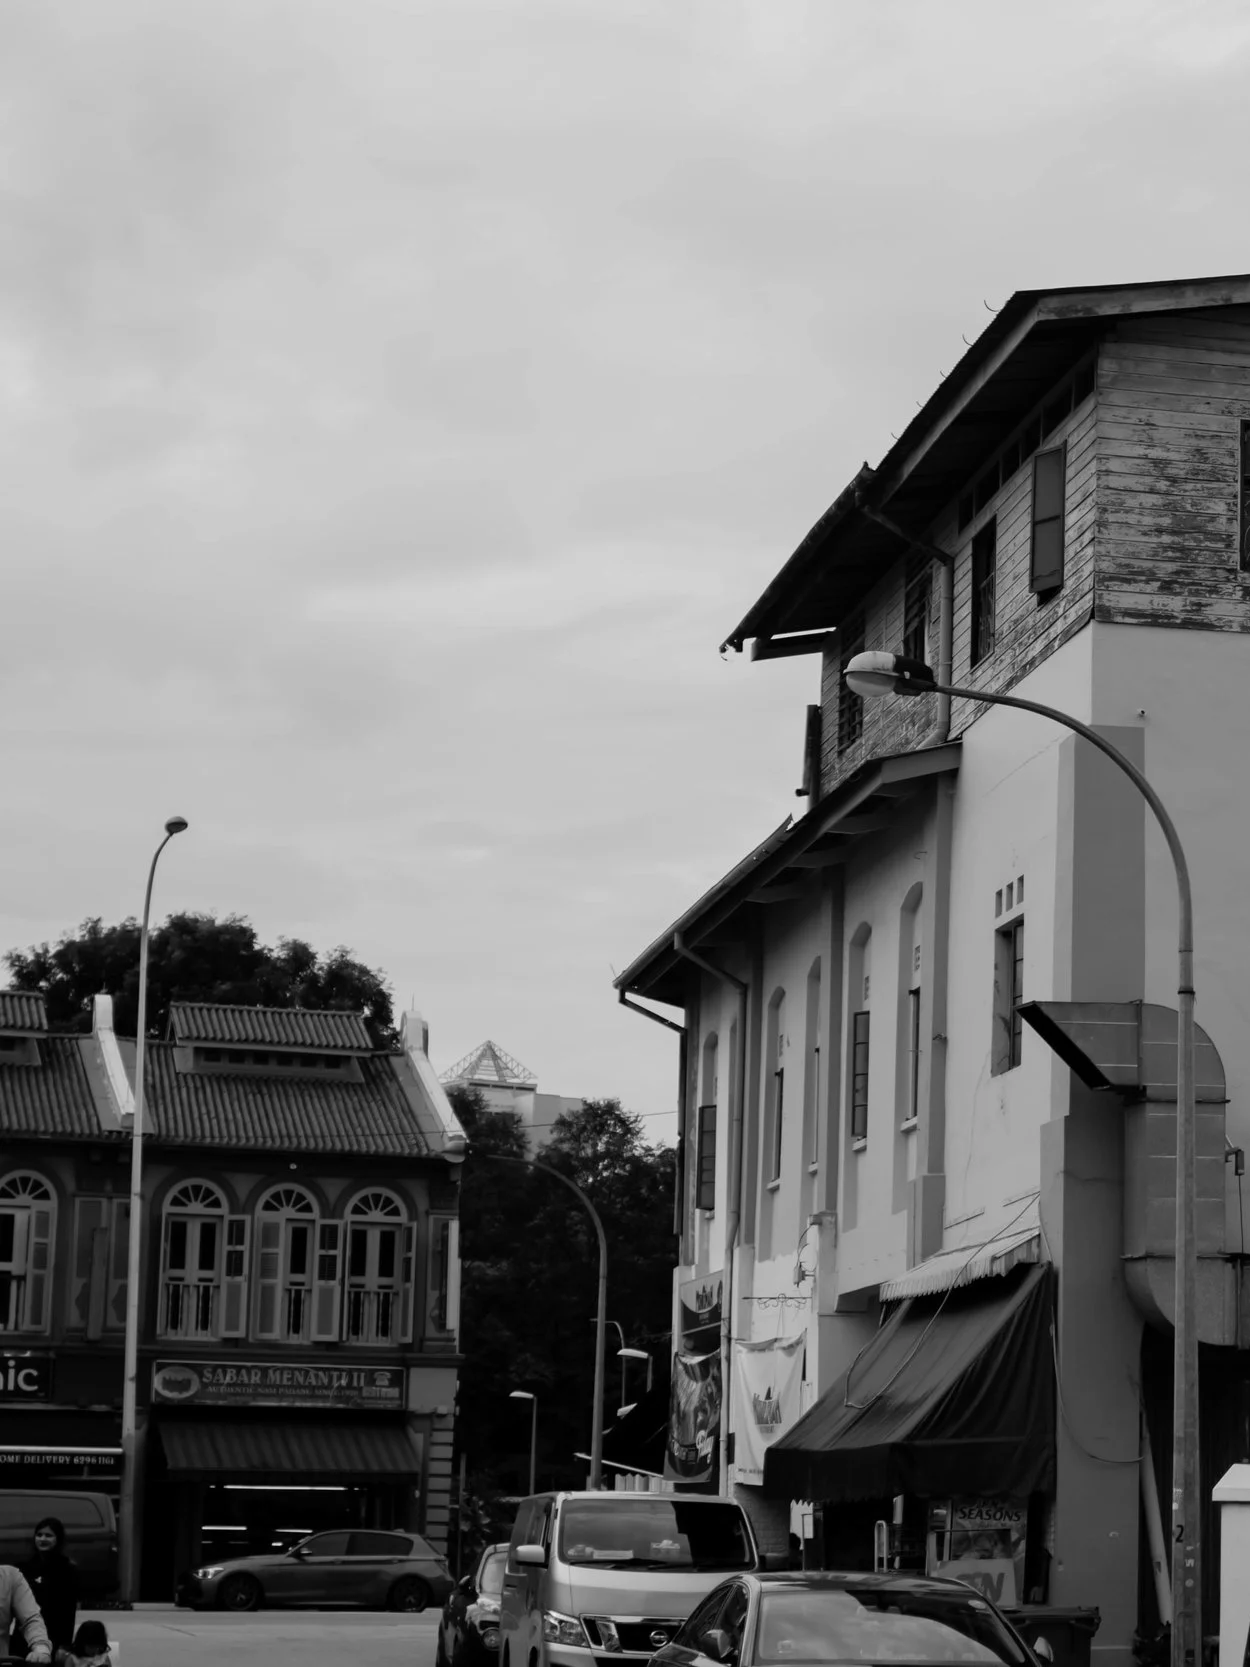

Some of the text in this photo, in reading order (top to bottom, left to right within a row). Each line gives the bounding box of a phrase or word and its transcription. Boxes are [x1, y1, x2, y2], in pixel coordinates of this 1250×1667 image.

[0, 1359, 39, 1392] ic
[202, 1367, 366, 1387] SABAR MENANTI II
[24, 1454, 71, 1465] DELIVERY
[958, 1506, 1022, 1522] SEASONS
